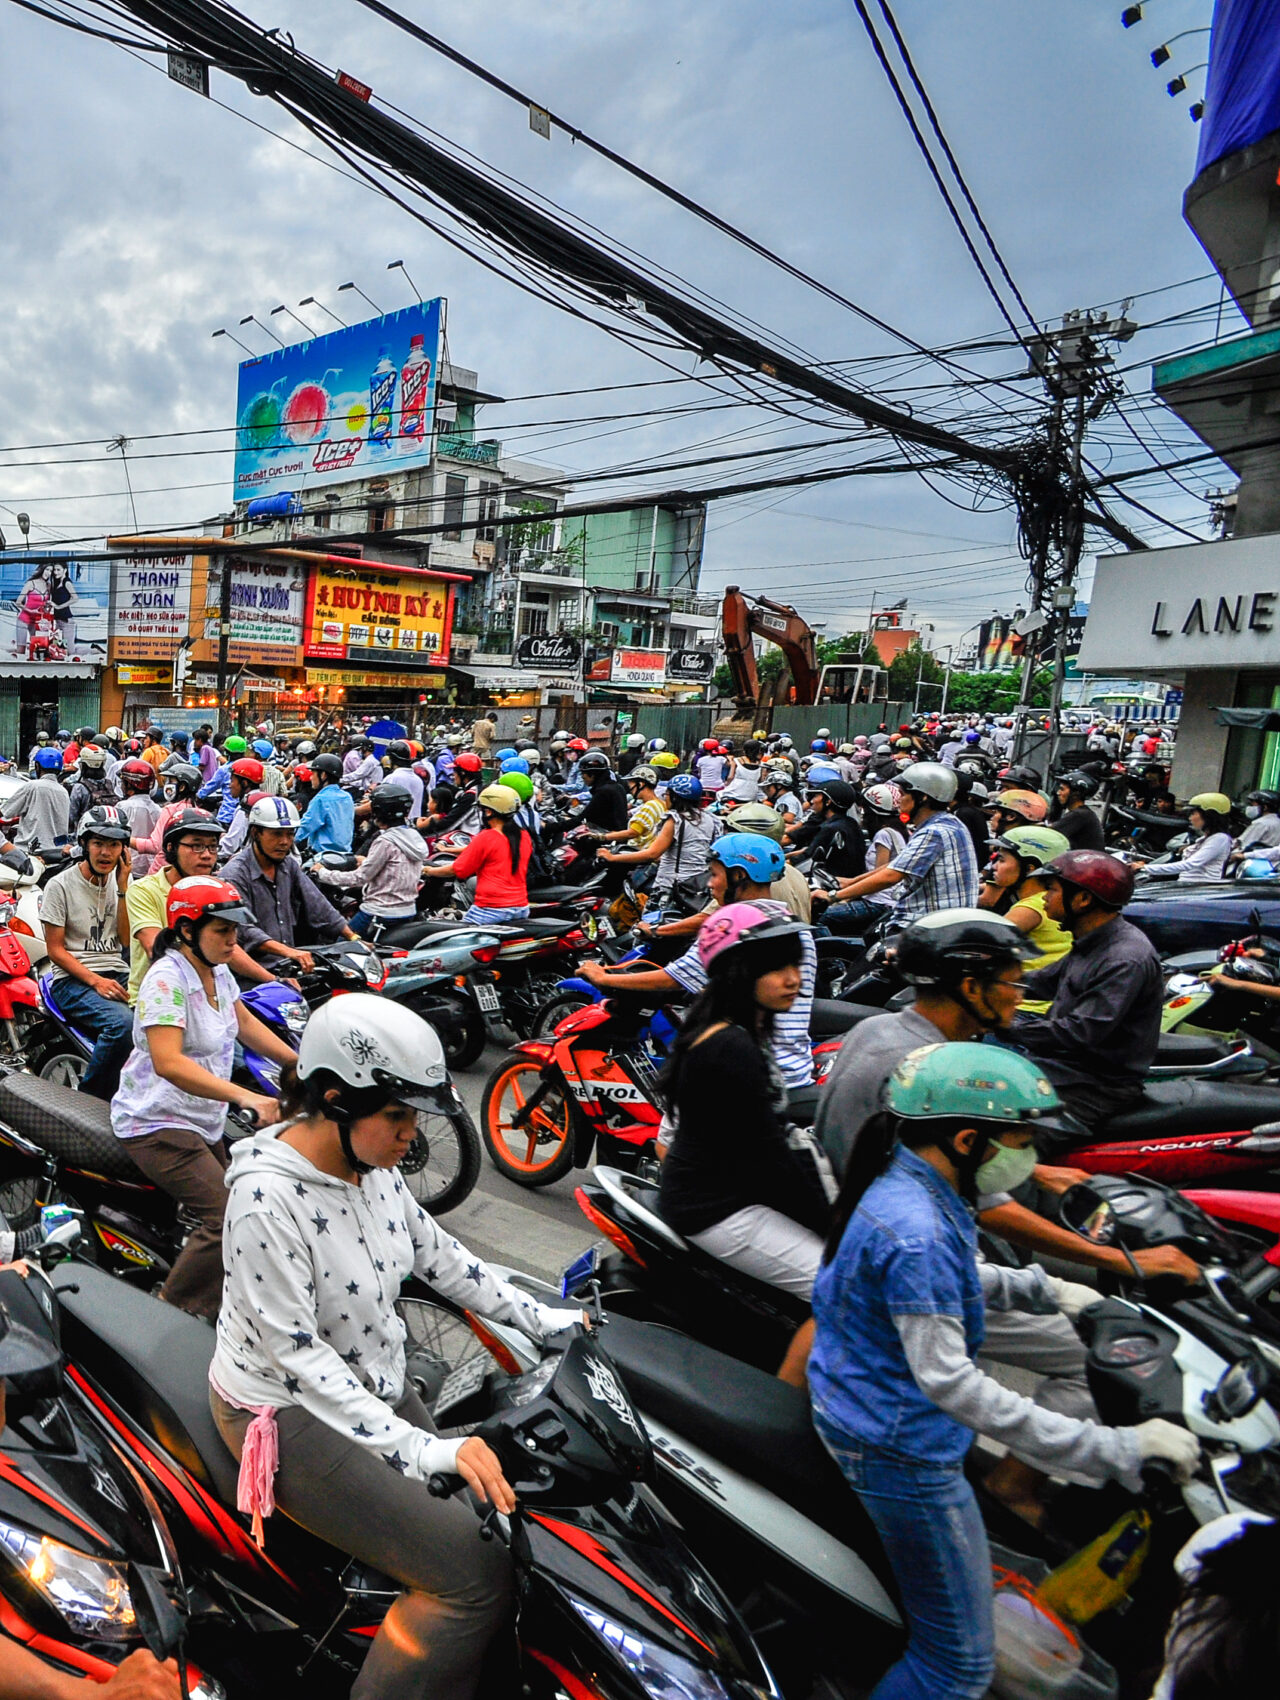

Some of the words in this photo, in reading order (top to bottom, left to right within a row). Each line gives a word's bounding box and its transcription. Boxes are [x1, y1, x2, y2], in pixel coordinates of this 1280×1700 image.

[130, 572, 179, 587] THANH
[132, 589, 174, 606] XUÂN
[1151, 592, 1278, 637] LANE
[628, 654, 659, 667] TOTAL
